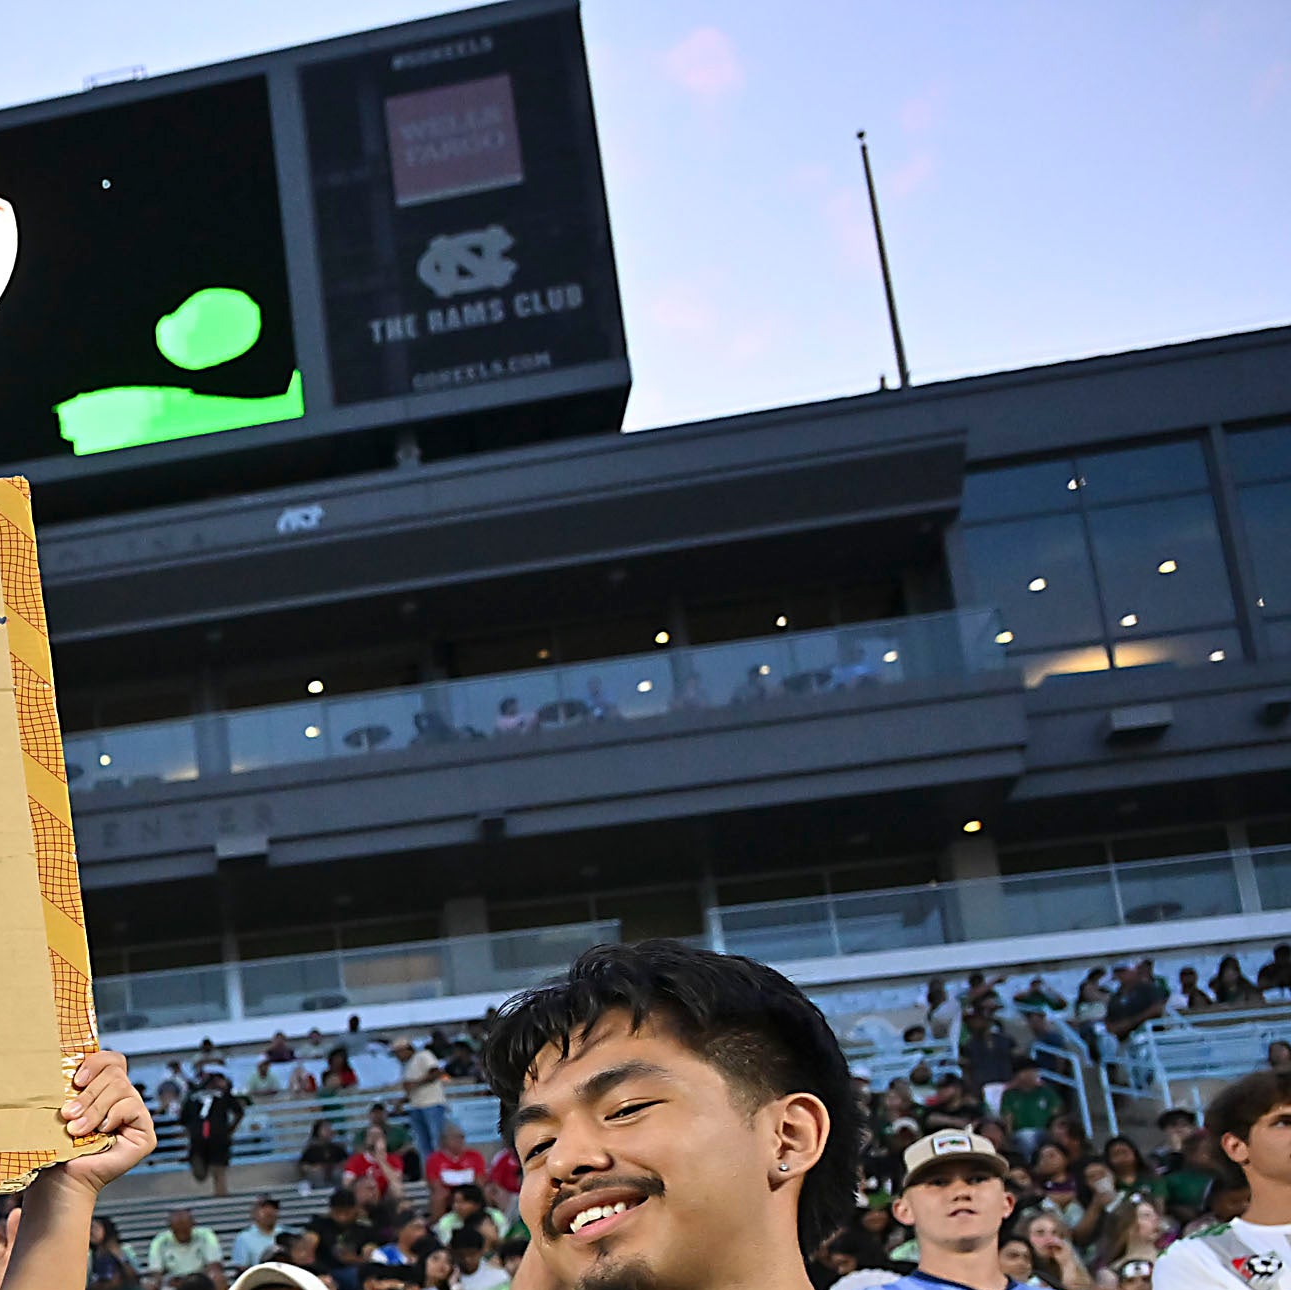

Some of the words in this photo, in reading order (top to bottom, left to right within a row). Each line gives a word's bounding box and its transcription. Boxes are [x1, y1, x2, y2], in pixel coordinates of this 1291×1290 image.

[369, 313, 420, 345] THE
[427, 298, 506, 335] RAMS
[513, 283, 584, 318] CLUB
